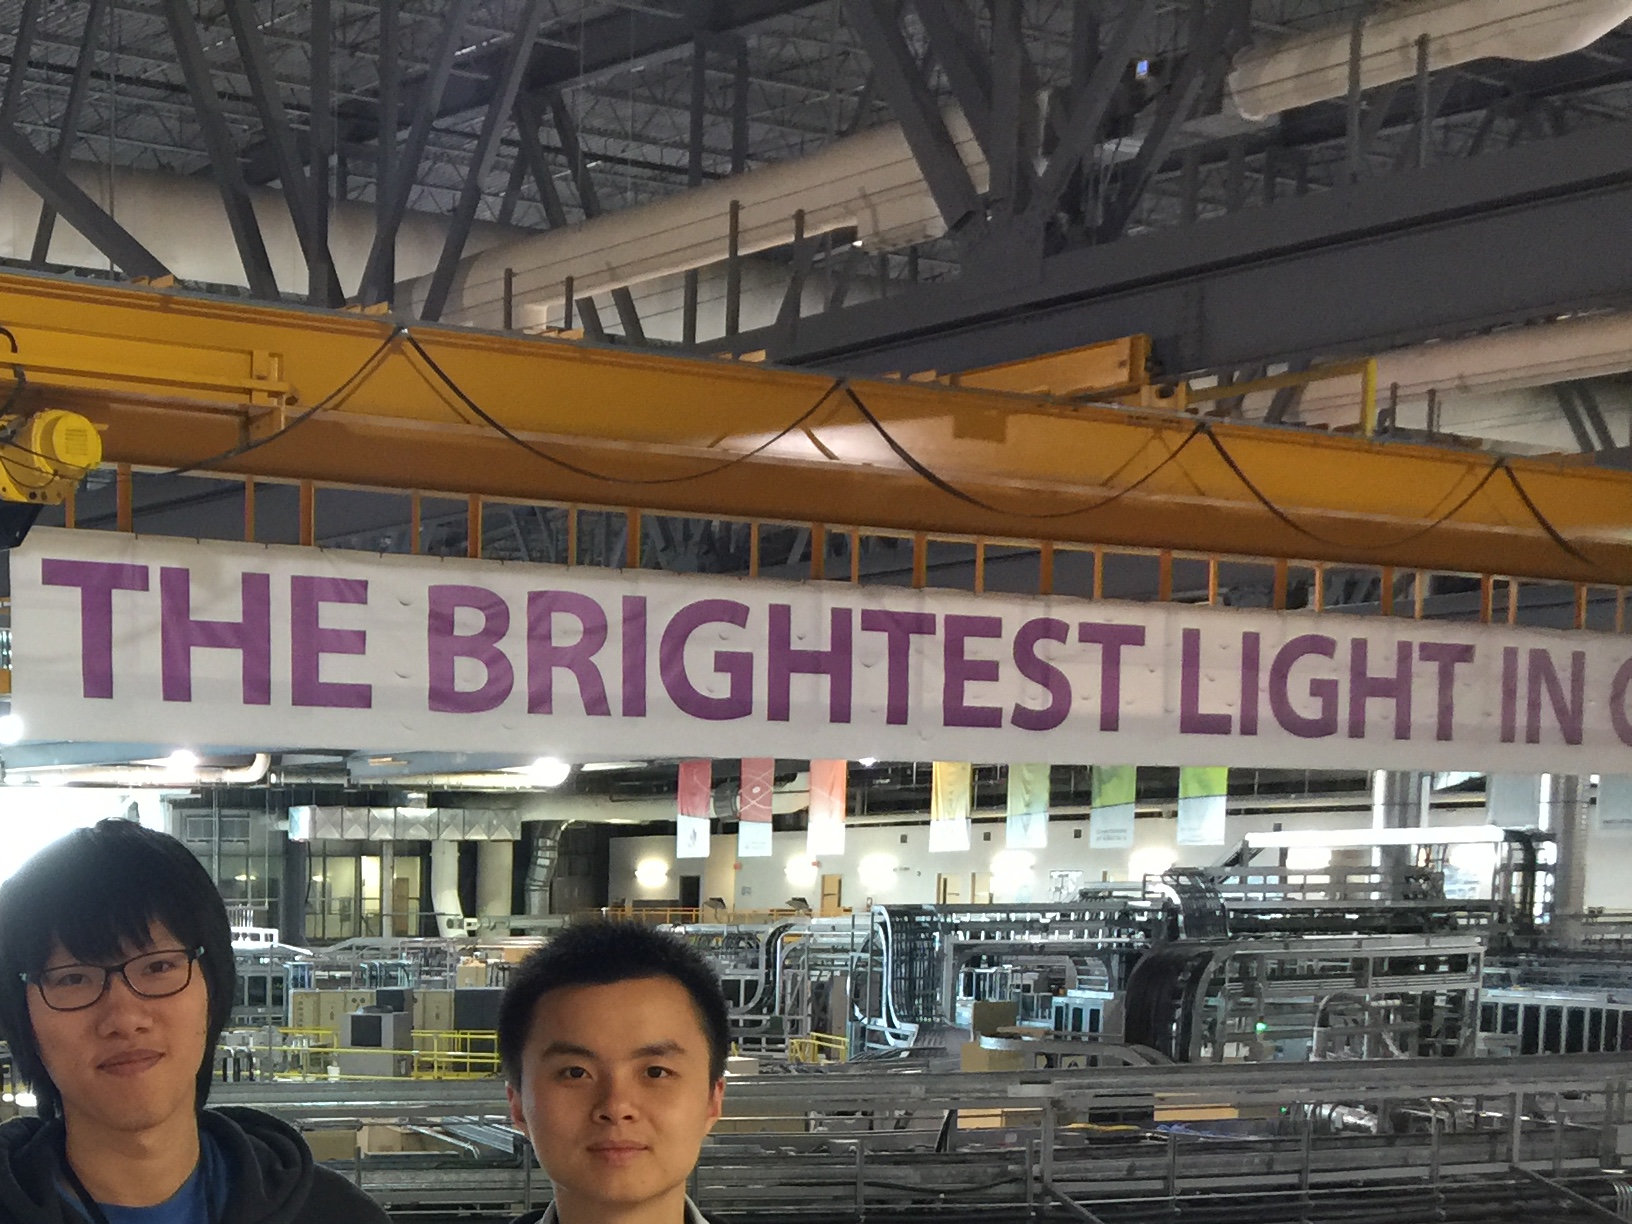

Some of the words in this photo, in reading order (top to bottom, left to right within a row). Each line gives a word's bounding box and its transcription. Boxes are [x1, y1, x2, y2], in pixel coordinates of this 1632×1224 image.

[41, 557, 372, 710] THE
[427, 583, 1146, 732] BRIGHTEST
[1179, 627, 1475, 742] LIGHT
[1499, 645, 1586, 746] IN
